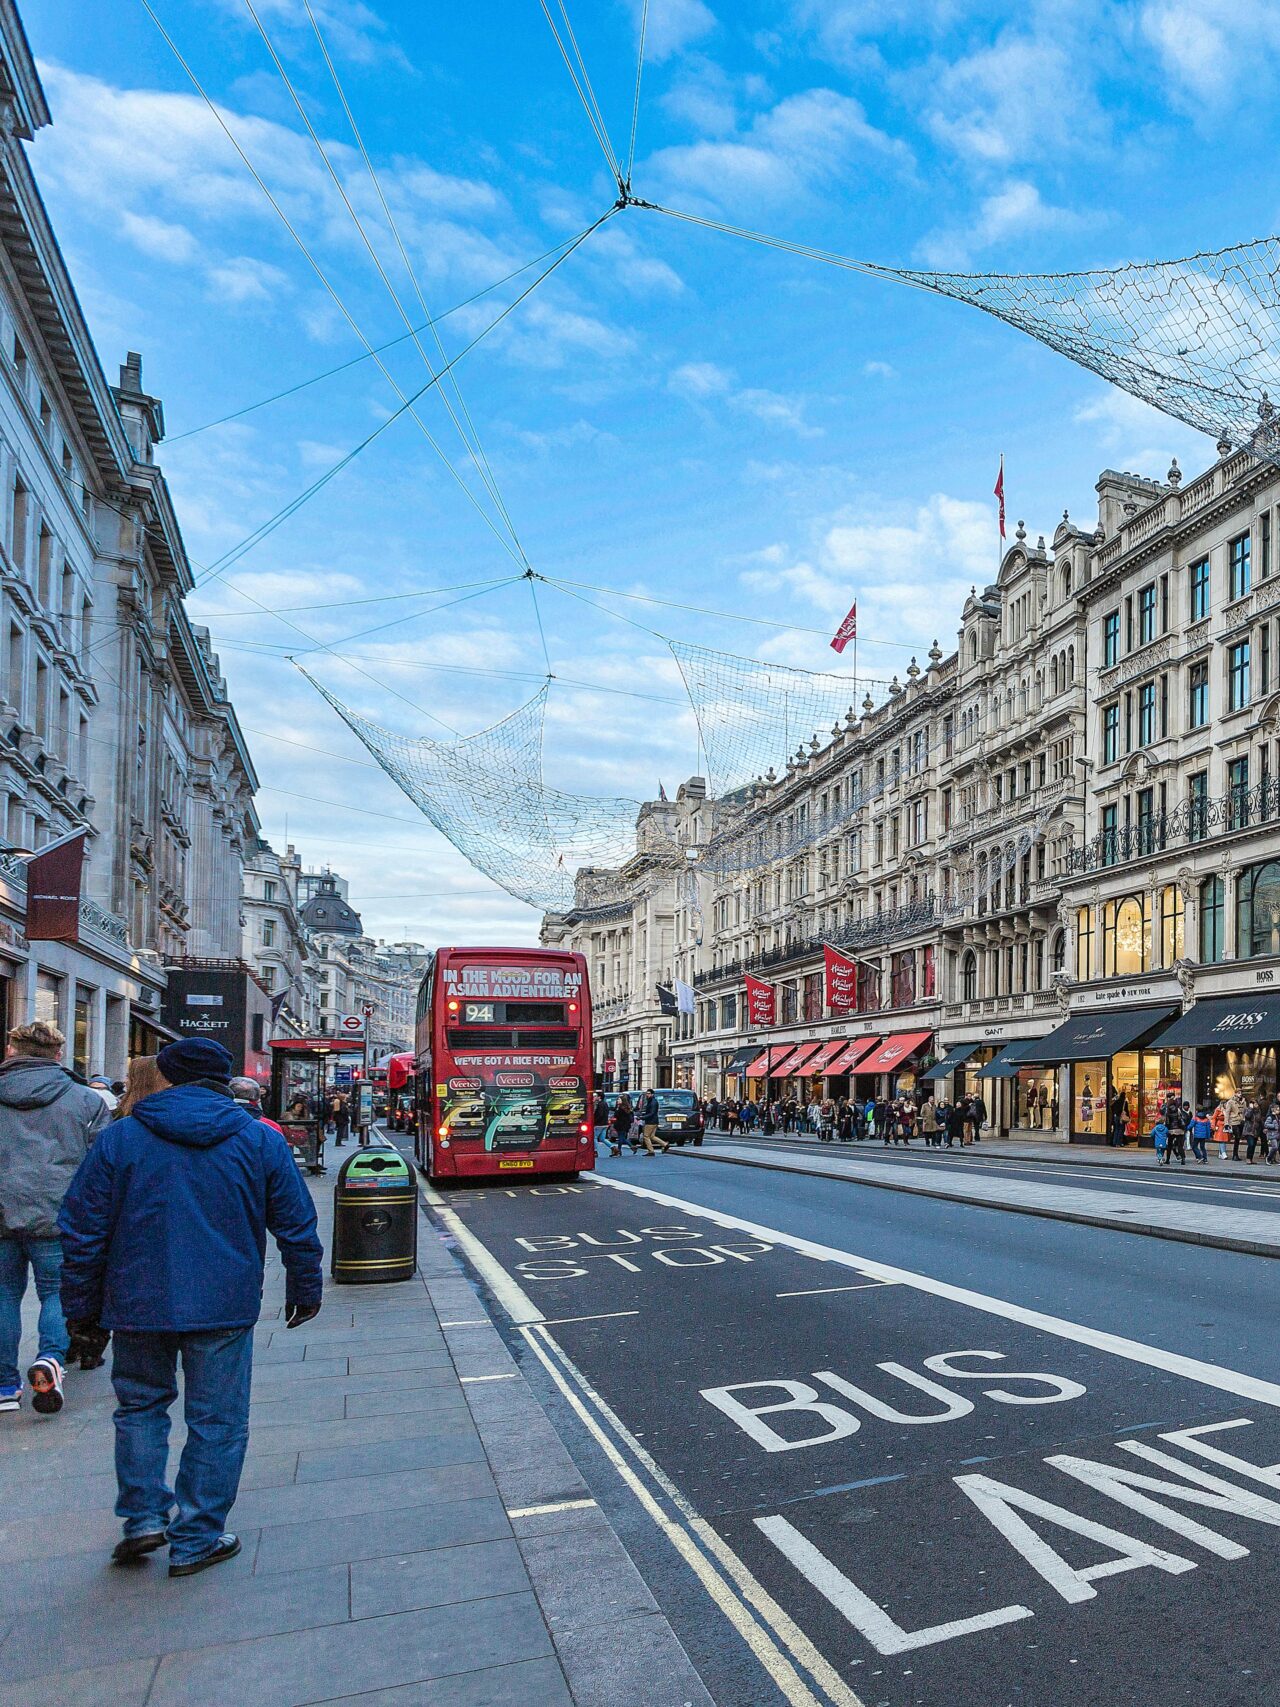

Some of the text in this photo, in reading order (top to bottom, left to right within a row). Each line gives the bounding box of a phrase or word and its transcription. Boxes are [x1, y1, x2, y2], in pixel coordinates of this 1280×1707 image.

[443, 969, 582, 986] IN THE MOOD FOR AN
[1256, 970, 1274, 981] BOSS
[447, 983, 579, 998] ASIAN ADVENTURE?
[1095, 992, 1106, 1000] kate
[1106, 989, 1120, 1001] spade
[1138, 988, 1151, 996] YORK
[363, 1006, 373, 1014] M
[465, 1005, 492, 1021] 94
[180, 1019, 230, 1028] HACKETT
[1216, 1011, 1268, 1027] BOSS
[984, 1028, 1004, 1036] GANT
[454, 1056, 576, 1066] WE'VE GOT A RICE FOR THAT.
[452, 1080, 479, 1088] Veetee
[500, 1075, 531, 1085] Veetee
[551, 1079, 577, 1087] Veetee
[1242, 1075, 1255, 1083] BOSS
[514, 1225, 703, 1253] BUS
[514, 1242, 774, 1281] STOP
[699, 1347, 1087, 1454] BUS
